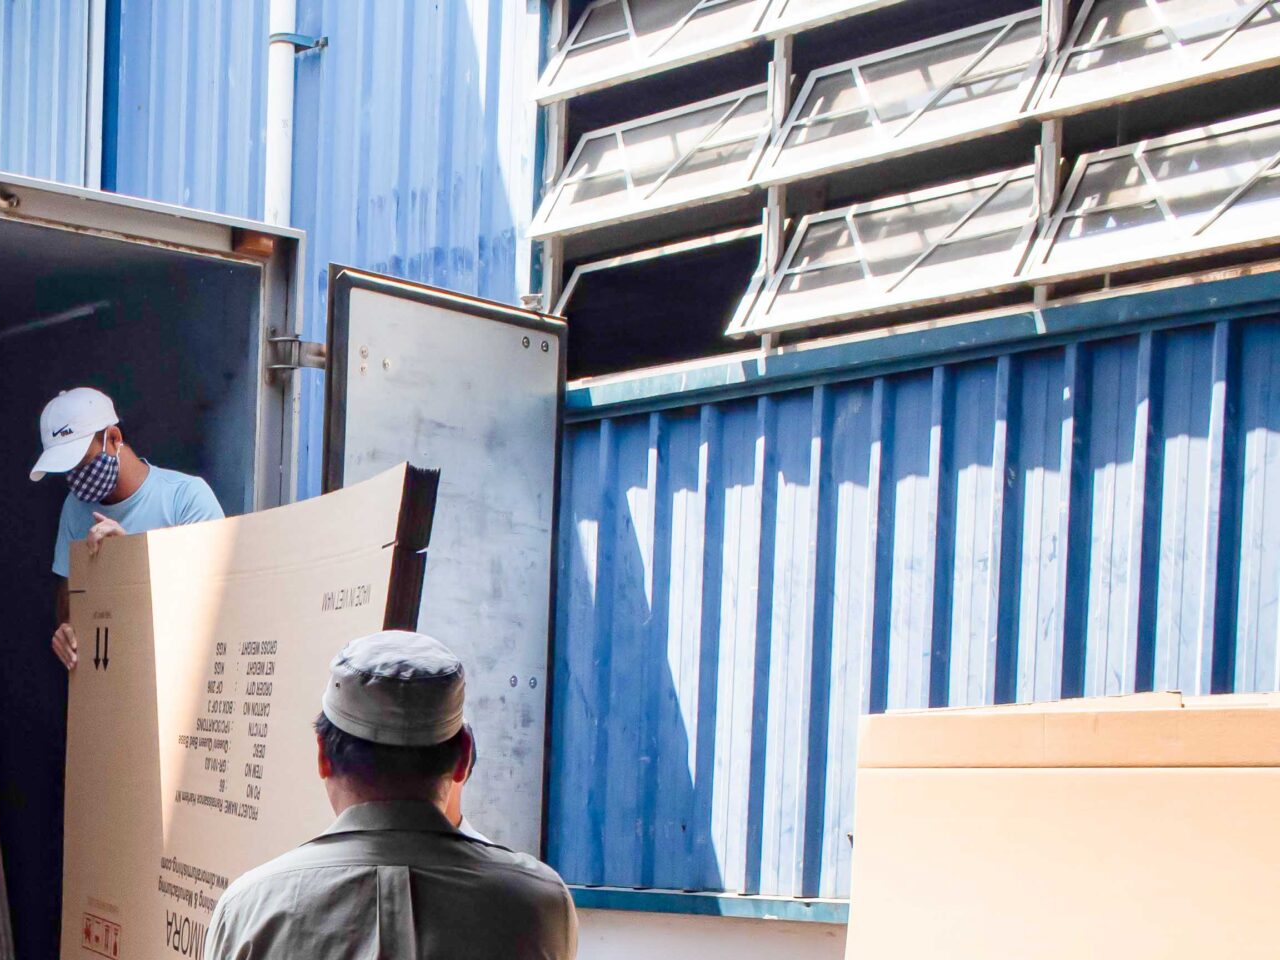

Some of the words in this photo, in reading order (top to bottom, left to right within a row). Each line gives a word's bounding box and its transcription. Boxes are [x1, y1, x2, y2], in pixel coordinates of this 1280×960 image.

[216, 642, 227, 656] KGS
[261, 641, 277, 655] GROSS
[214, 662, 224, 675] KGS
[246, 662, 265, 675] WEIGHT
[265, 662, 275, 675] NET
[256, 682, 272, 696] ORDER
[222, 700, 233, 714] BOX
[243, 702, 251, 715] NO
[251, 702, 270, 717] CARTON
[253, 744, 265, 758] DESC
[252, 764, 263, 779] ITEM
[238, 803, 259, 821] PROJECT
[158, 875, 194, 908] Manufacturing
